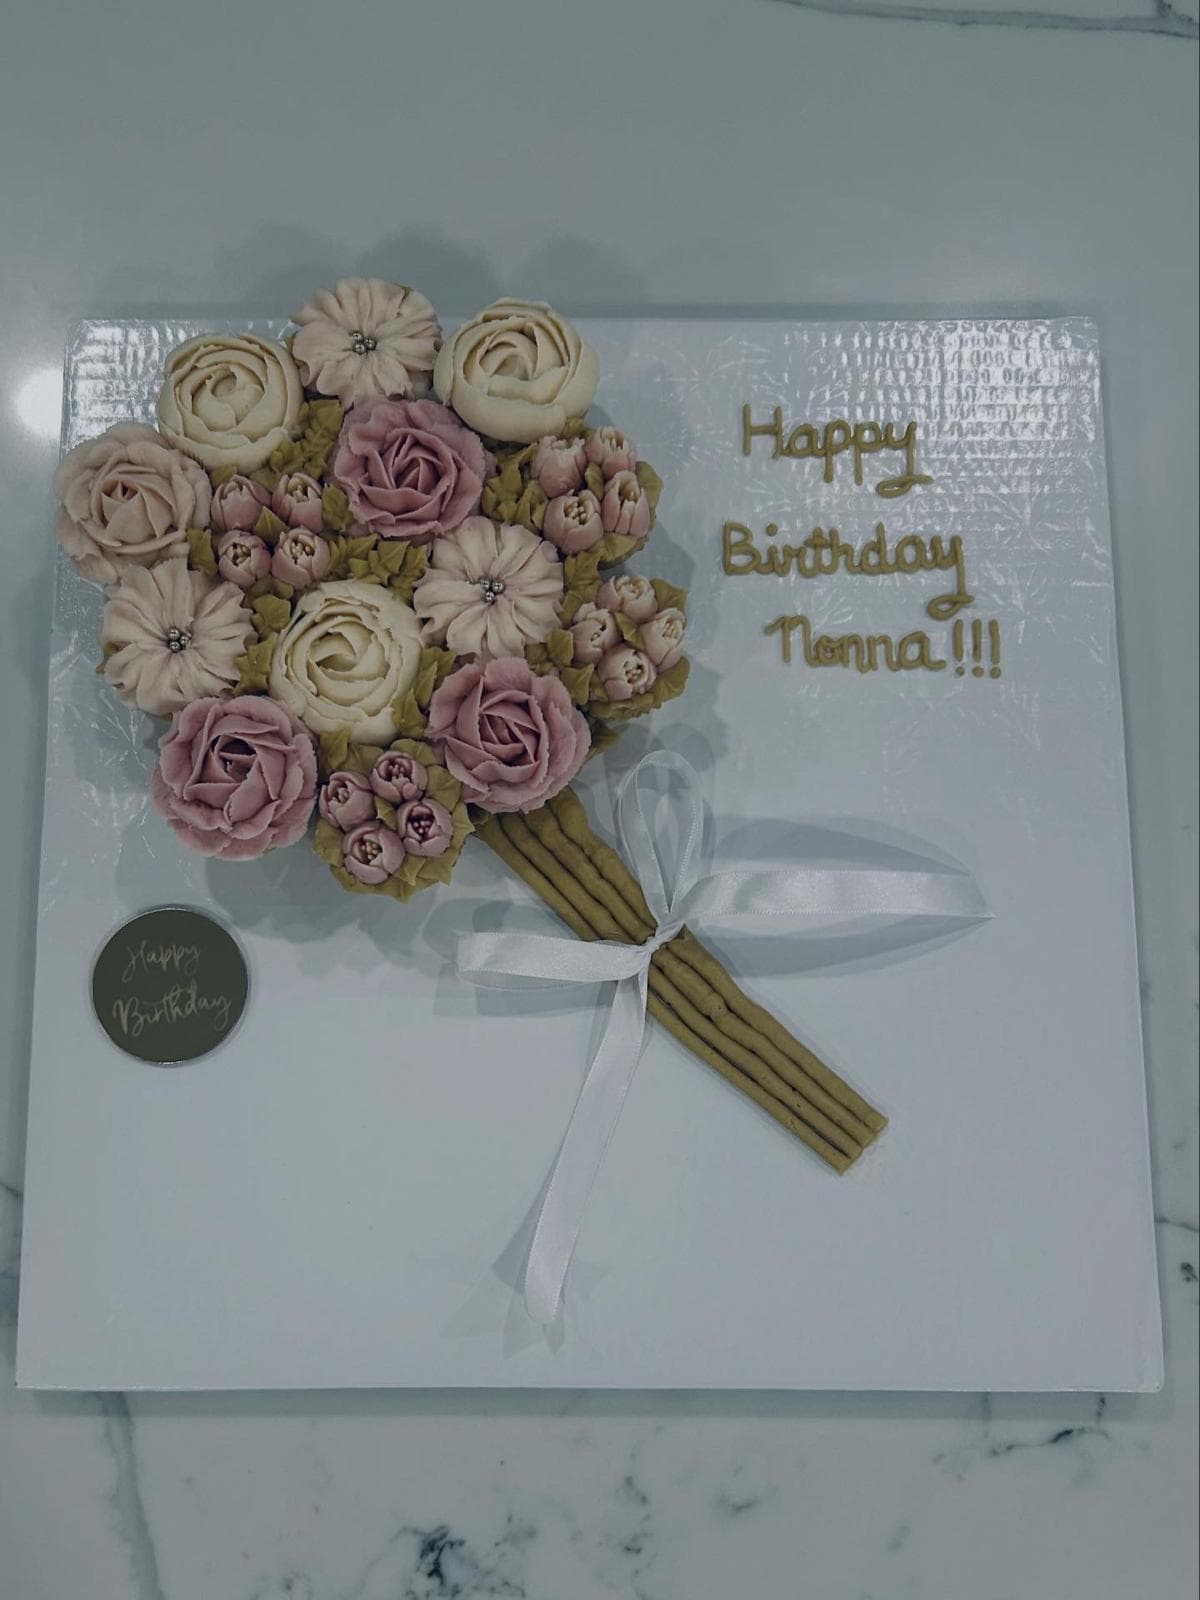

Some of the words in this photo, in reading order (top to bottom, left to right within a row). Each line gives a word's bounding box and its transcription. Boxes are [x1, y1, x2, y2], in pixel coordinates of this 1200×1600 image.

[742, 403, 934, 498] Happy
[722, 520, 975, 621] Birthday
[122, 940, 203, 983] Happy
[112, 979, 232, 1037] Birthday
